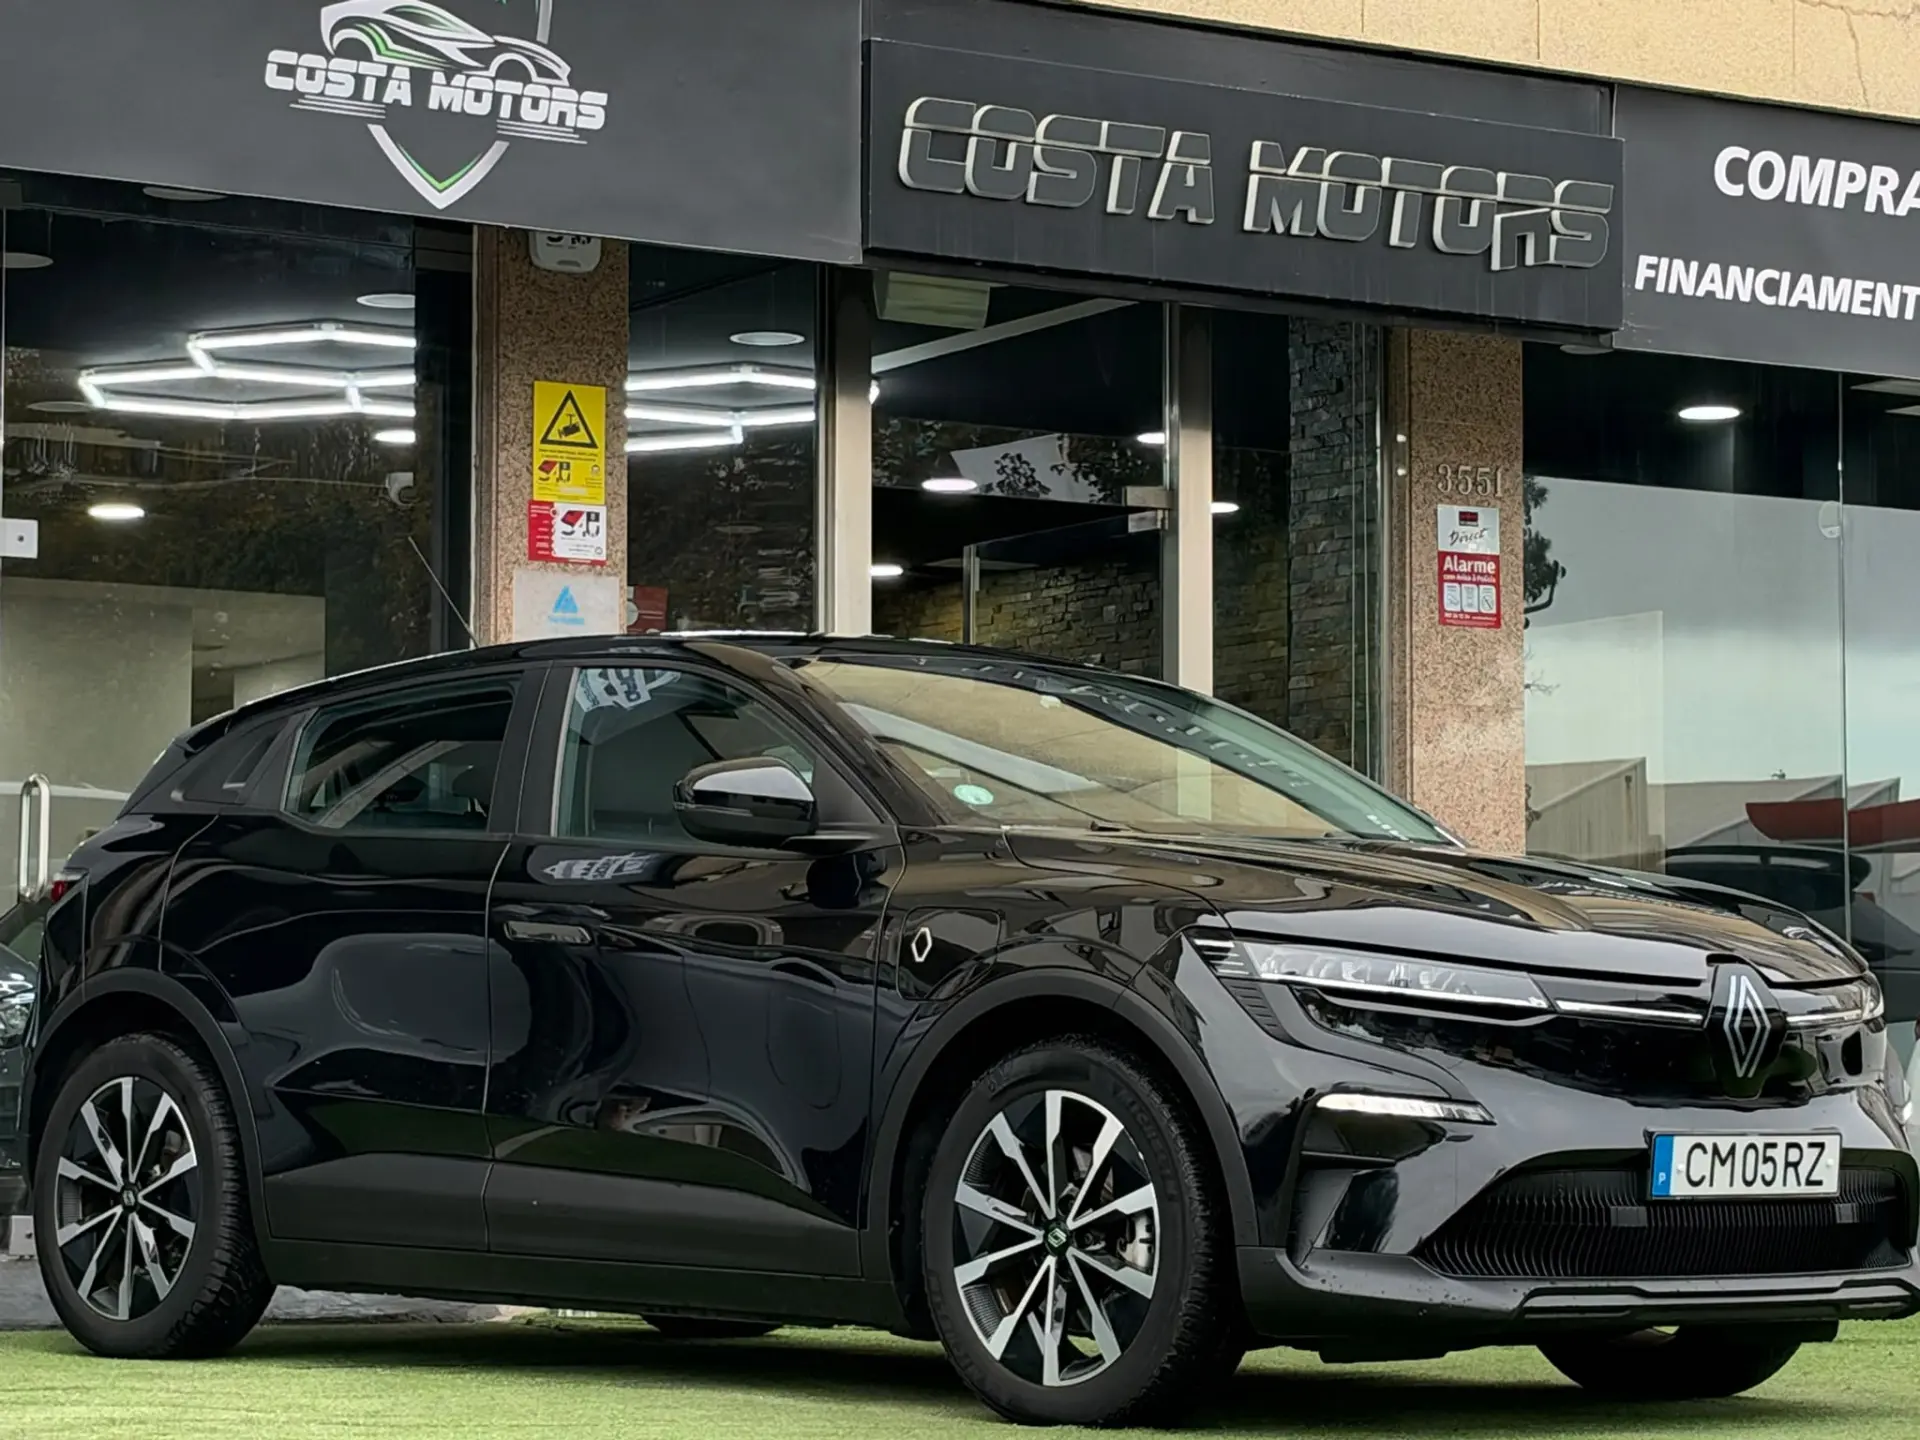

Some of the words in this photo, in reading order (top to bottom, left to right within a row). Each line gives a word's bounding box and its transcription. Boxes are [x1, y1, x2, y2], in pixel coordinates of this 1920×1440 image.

[264, 49, 412, 107] COSTA
[428, 70, 608, 131] MOTORS
[898, 96, 1215, 225] COSTA
[1243, 140, 1615, 272] MOTORS
[1437, 463, 1503, 498] 3551
[1448, 527, 1490, 546] Direct
[1443, 555, 1496, 574] Alarme
[1658, 1171, 1667, 1185] P
[1686, 1142, 1825, 1188] CM05RZ
